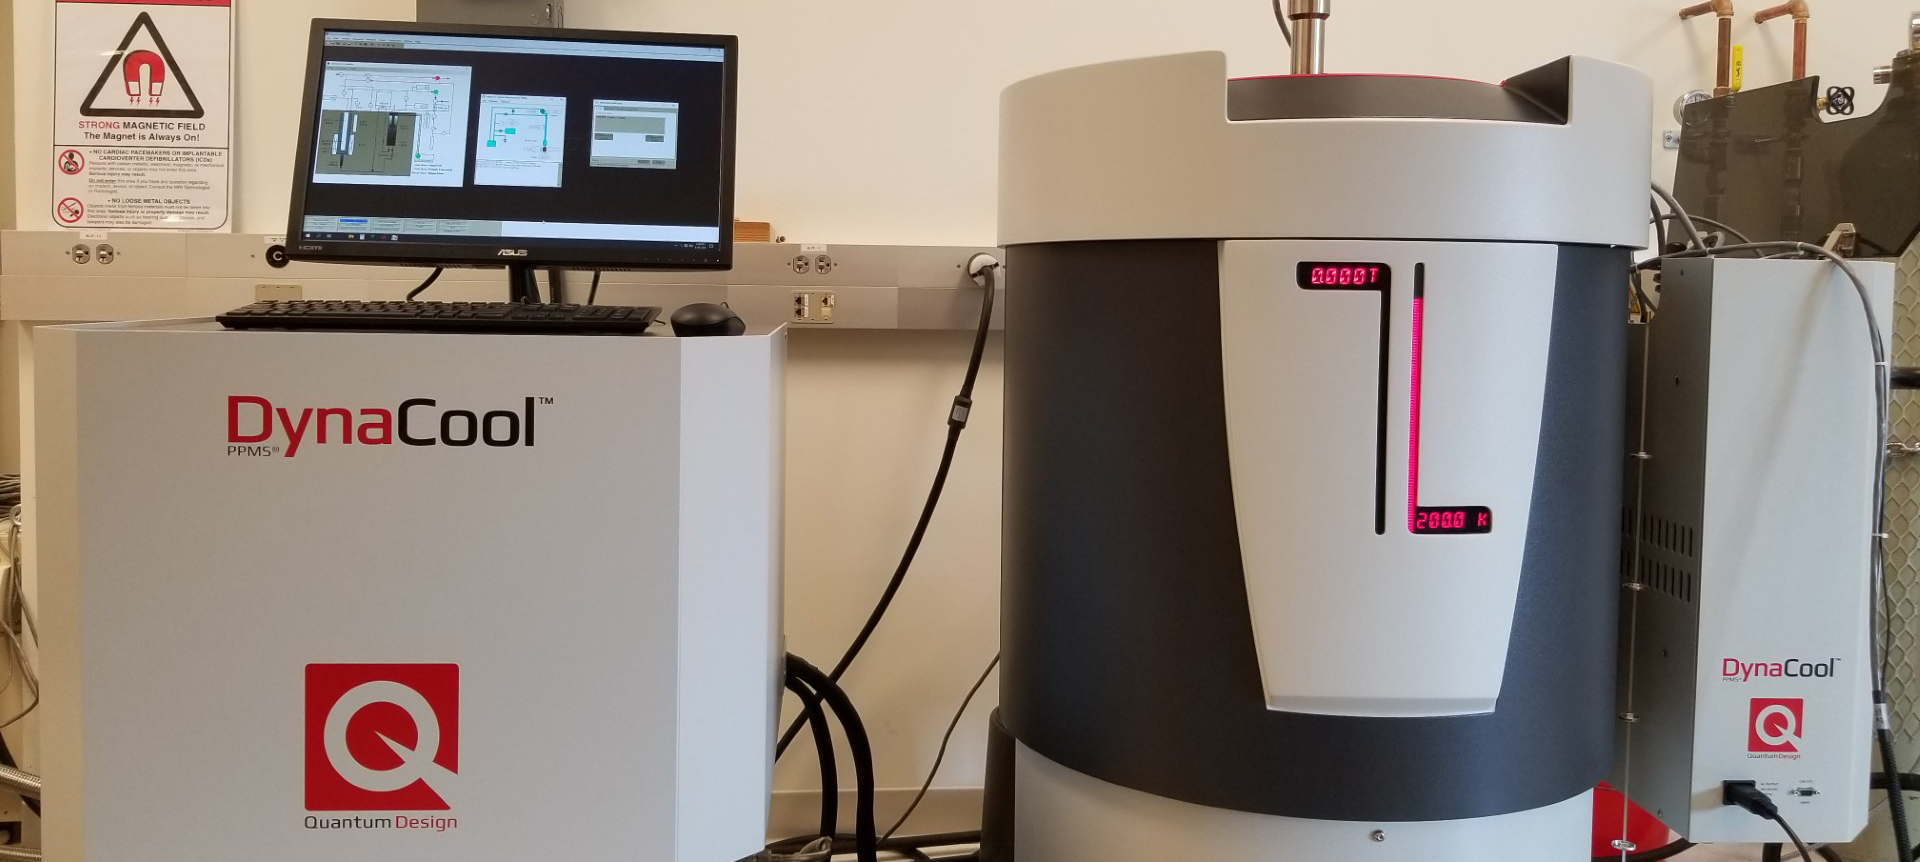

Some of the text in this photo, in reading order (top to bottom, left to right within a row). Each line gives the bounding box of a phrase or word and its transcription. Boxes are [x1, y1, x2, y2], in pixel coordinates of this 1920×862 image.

[78, 120, 206, 130] STRONG MAGNETIC FIELD
[104, 132, 136, 141] Magnet
[148, 133, 181, 142] Always
[1477, 512, 1489, 527] K
[304, 816, 458, 832] Quantum Design
